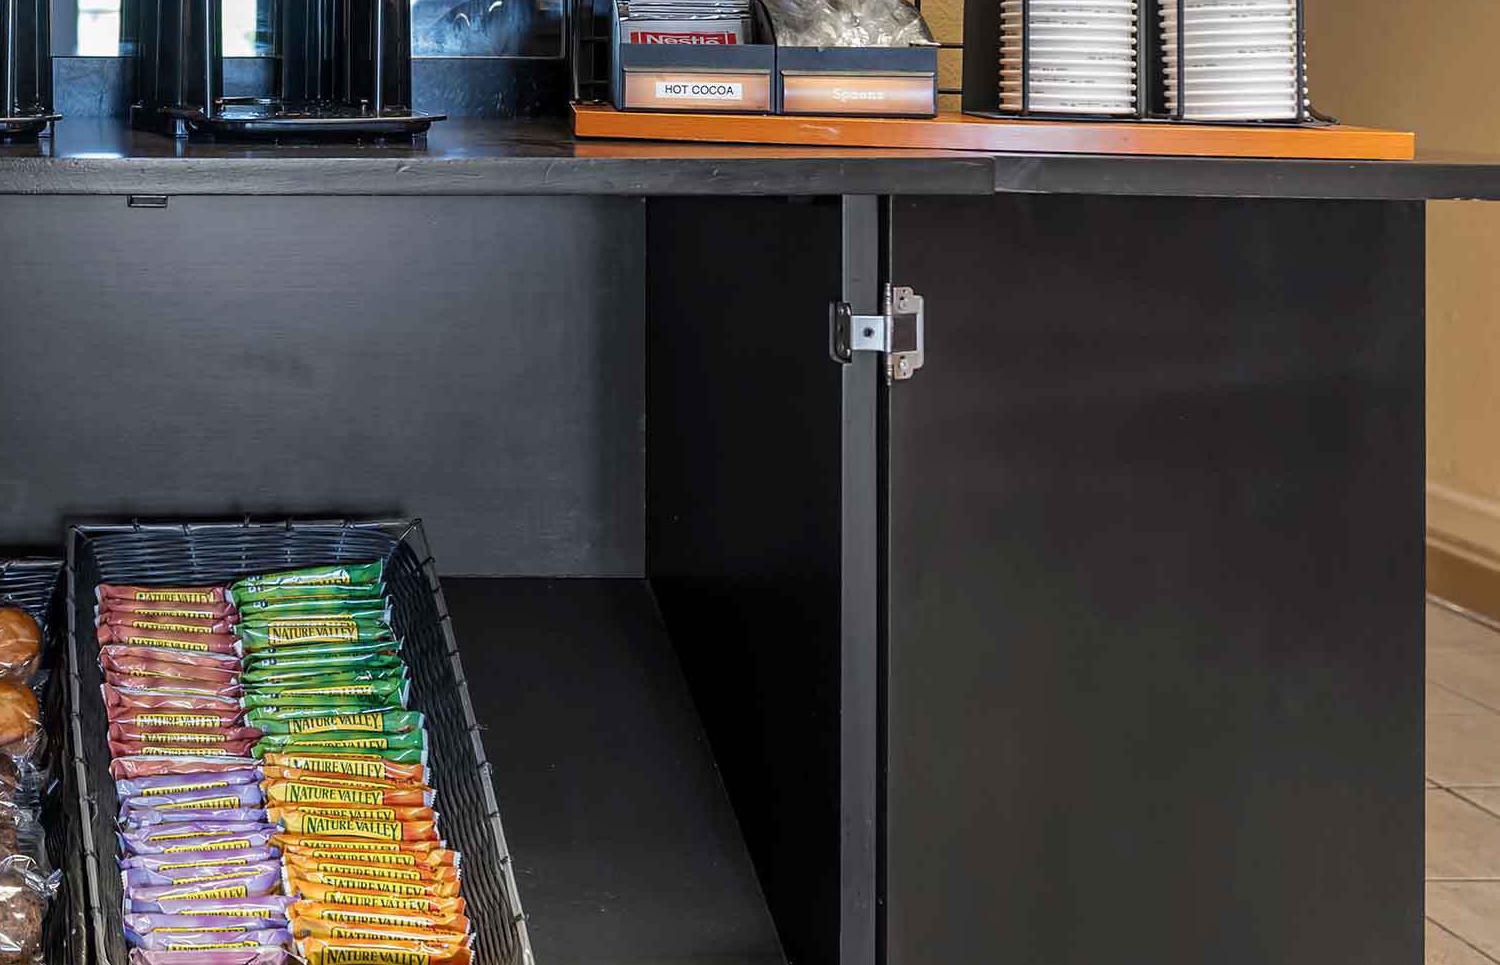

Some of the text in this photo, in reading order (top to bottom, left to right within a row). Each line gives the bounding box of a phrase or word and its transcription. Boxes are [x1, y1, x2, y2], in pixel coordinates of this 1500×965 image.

[664, 84, 734, 95] HOT COCOA
[272, 626, 355, 640] NATURE VALLEY
[292, 713, 380, 733] NATURE VALLEY
[340, 761, 381, 778] VALLEY
[290, 784, 381, 805] NATURE VALLEY
[307, 816, 399, 841] NATURE VALLEY
[326, 949, 426, 965] NATURE VALLEY
